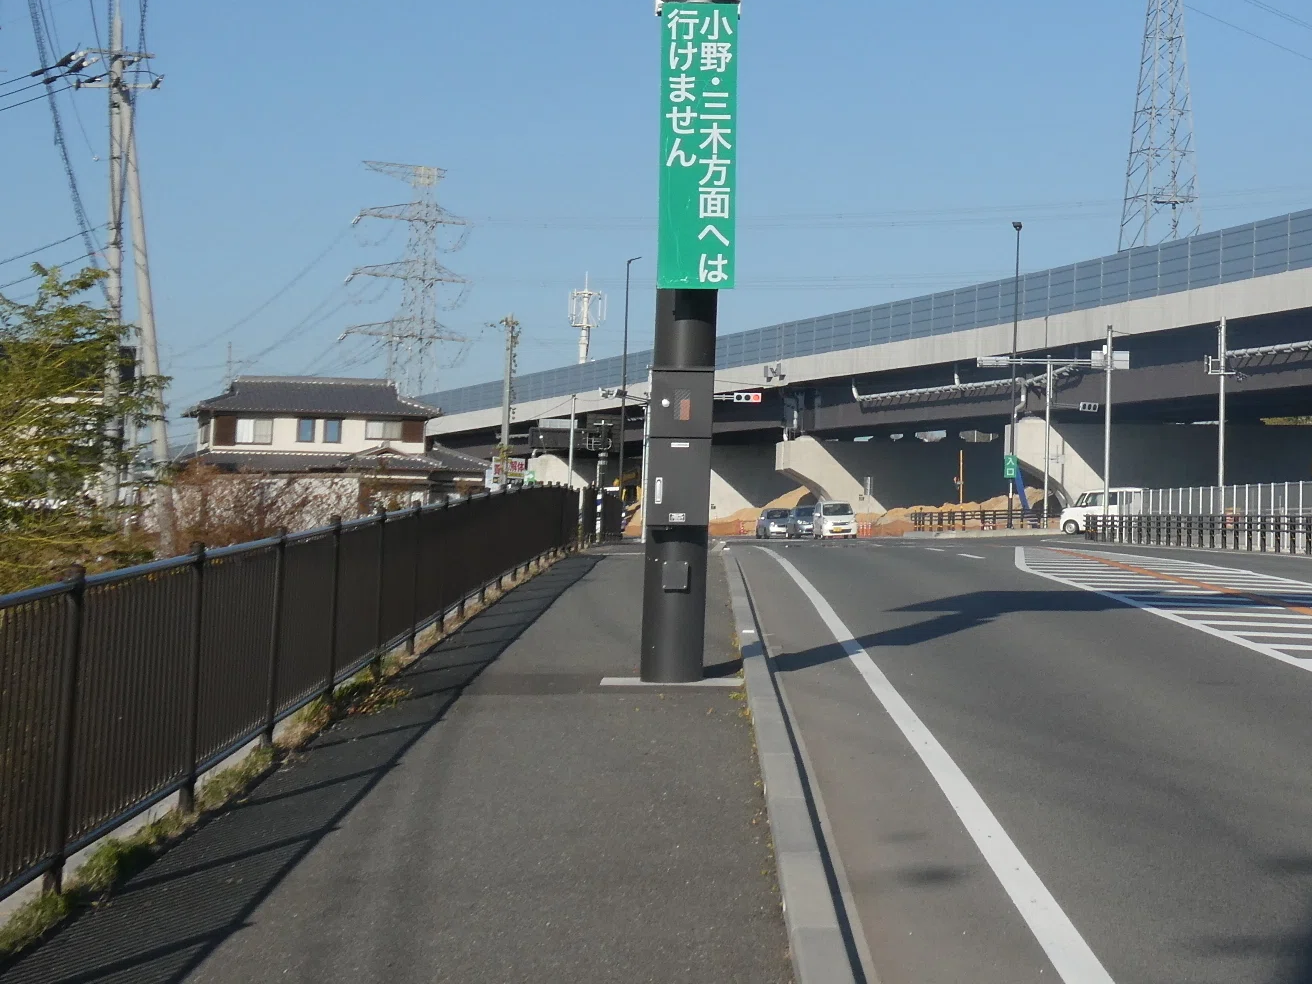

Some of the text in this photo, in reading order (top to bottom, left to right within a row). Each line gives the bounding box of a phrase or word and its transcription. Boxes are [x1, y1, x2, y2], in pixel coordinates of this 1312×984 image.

[666, 8, 700, 168] 行けません
[698, 9, 733, 283] 小野・三木方面へは
[1006, 457, 1015, 476] 入口
